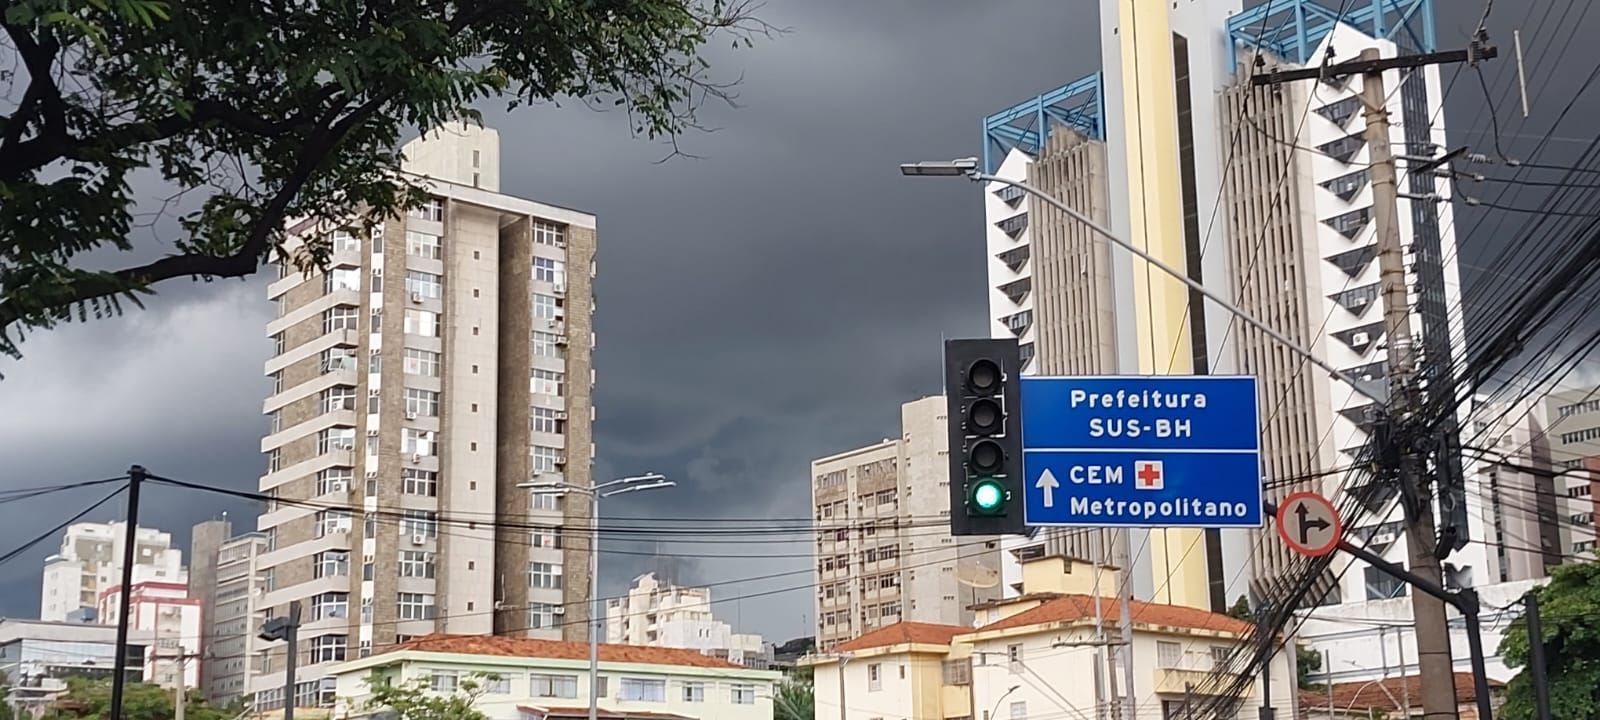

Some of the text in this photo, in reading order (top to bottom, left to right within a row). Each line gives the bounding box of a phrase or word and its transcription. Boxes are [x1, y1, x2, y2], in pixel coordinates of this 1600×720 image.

[1071, 390, 1207, 409] Prefeitura
[1089, 418, 1191, 438] SUS-BH
[1069, 465, 1123, 484] CEM
[1070, 497, 1248, 519] Metropolitano
